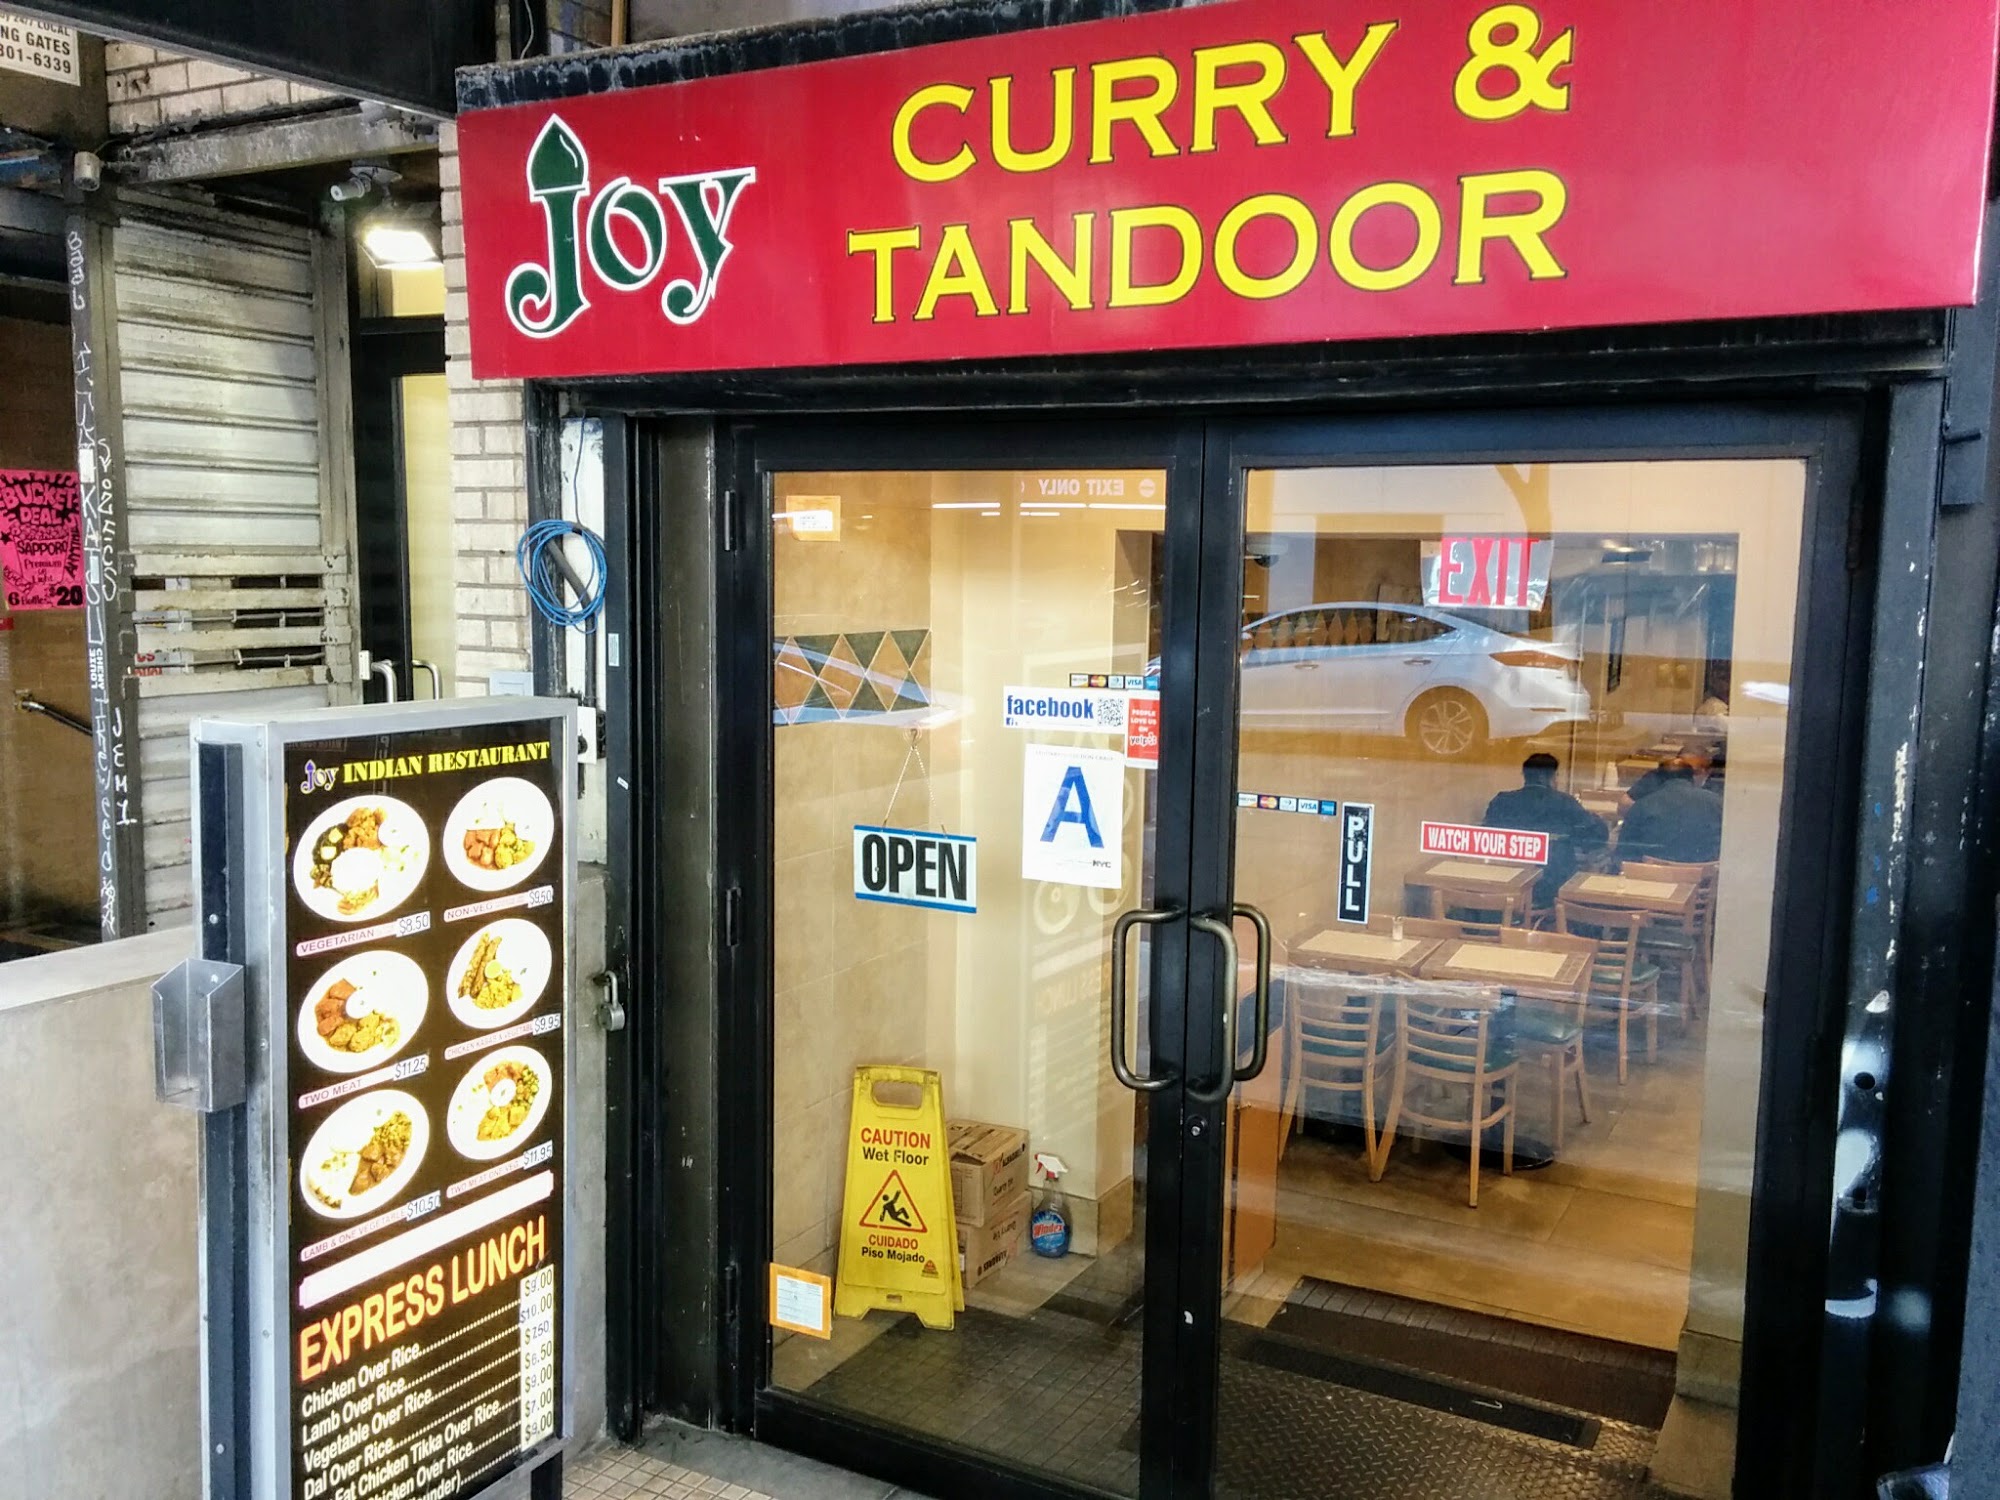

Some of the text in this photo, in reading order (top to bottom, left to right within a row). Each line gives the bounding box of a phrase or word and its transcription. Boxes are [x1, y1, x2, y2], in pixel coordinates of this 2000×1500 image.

[26, 32, 70, 56] GATES
[891, 3, 1574, 184] CURRY &
[847, 167, 1567, 324] TANDOOR
[3, 481, 75, 511] BUCKET
[20, 506, 62, 525] DEAL
[17, 541, 68, 556] SAPPORO
[1438, 536, 1540, 608] EXIT
[8, 592, 20, 606] 6
[1007, 694, 1094, 719] facebook
[1130, 717, 1147, 725] LOVE
[1131, 709, 1156, 717] PEOPLE
[1130, 735, 1147, 746] yelp
[300, 742, 549, 794] Joy INDIAN RESTAURANT
[1040, 766, 1104, 848] A
[1428, 827, 1541, 858] WATCH YOUR STEP
[862, 834, 967, 901] OPEN
[1345, 816, 1364, 911] PULL
[447, 902, 493, 920] NON-VEG
[301, 915, 430, 954] VEGETARIAN $8.50
[447, 1043, 474, 1058] CHICKEN
[504, 1023, 533, 1039] VEGETABL
[534, 1015, 560, 1033] $9.95
[304, 1058, 426, 1106] TWO MEAT $11.25
[861, 1127, 931, 1149] CAUTION
[863, 1147, 929, 1165] Wet Floor
[450, 1183, 466, 1196] TWO
[523, 1145, 551, 1166] $11.95
[304, 1242, 328, 1259] LAMB
[330, 1238, 337, 1247] &
[338, 1230, 356, 1244] ONE
[869, 1234, 918, 1250] CUIDADO
[1032, 1223, 1063, 1238] Windex
[861, 1246, 925, 1264] Piso Mojado
[300, 1215, 544, 1381] EXPRESS LUNCH
[302, 1376, 356, 1418] Chicken
[358, 1355, 390, 1388] Over
[391, 1343, 420, 1371] Rice
[303, 1410, 340, 1447] Lamb
[342, 1393, 374, 1424] Over
[376, 1377, 406, 1402] Rice
[303, 1423, 370, 1473] Vegetable
[371, 1404, 403, 1435] Over
[404, 1388, 432, 1417] Rice
[358, 1454, 409, 1496] Chicken
[410, 1433, 443, 1464] Tikka
[444, 1414, 473, 1444] Over
[474, 1399, 500, 1428] Rice
[368, 1387, 552, 1500] icken Over Rice $7.00
[304, 1470, 327, 1500] Dal
[329, 1454, 362, 1487] Over
[364, 1437, 394, 1467] Rice
